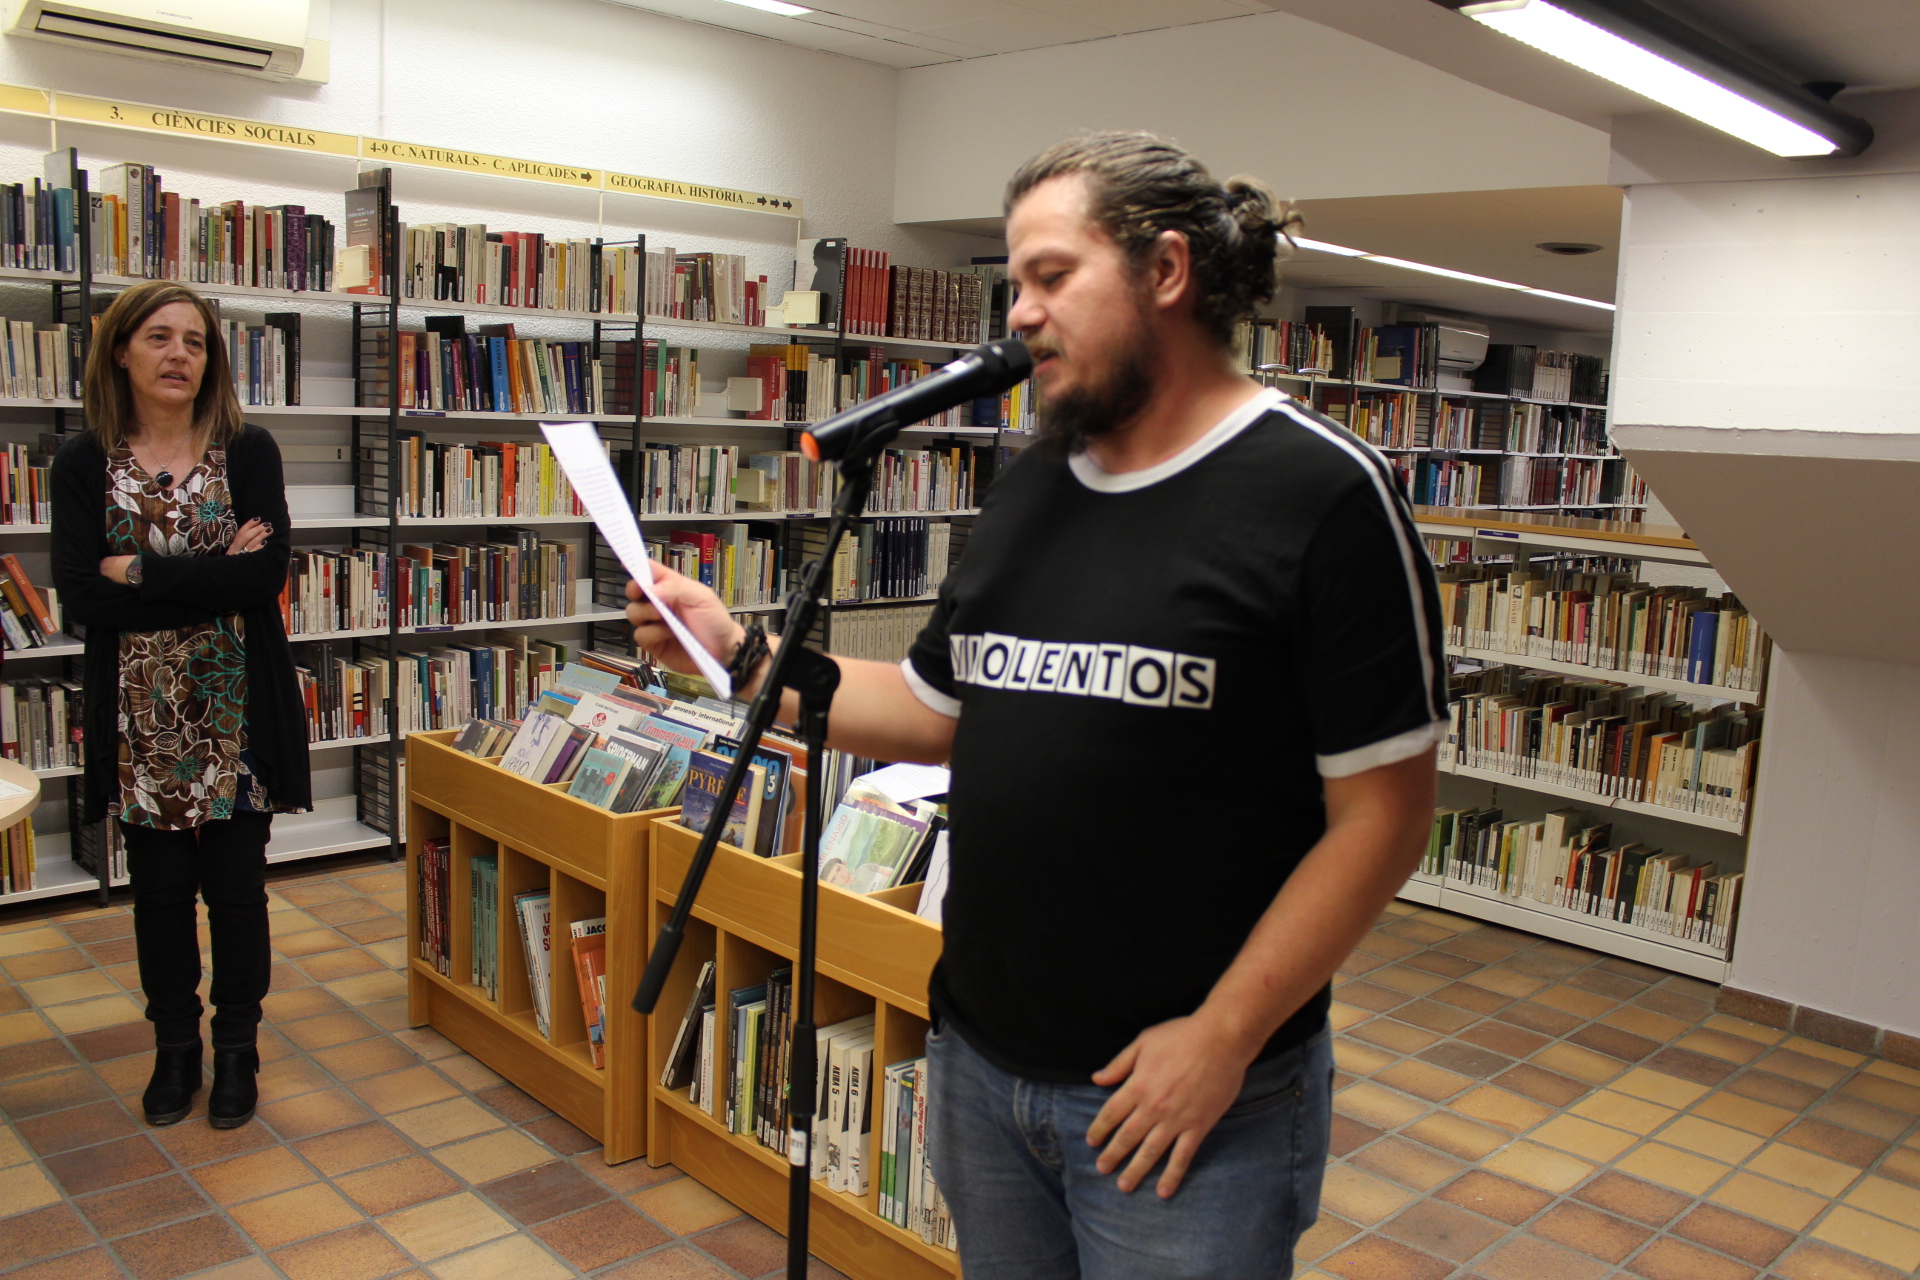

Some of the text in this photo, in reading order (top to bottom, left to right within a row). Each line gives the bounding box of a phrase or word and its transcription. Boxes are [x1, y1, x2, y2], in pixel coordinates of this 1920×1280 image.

[110, 106, 316, 147] 3. CIÈNCIES SOCIALS
[370, 141, 388, 154] 4-9
[391, 144, 405, 157] C.
[408, 146, 480, 167] NATURALS
[493, 159, 506, 171] C.
[508, 161, 577, 181] APLICADES
[611, 174, 686, 196] GEOGRAFIA.
[689, 184, 744, 204] HISTÒRIA
[673, 705, 697, 717] amnesty
[698, 712, 736, 727] international
[640, 716, 698, 750] Commerciaux
[606, 741, 650, 771] SPIDERMAN
[688, 769, 747, 801] PYRÈE
[767, 775, 776, 793] 3
[818, 813, 848, 867] MILENARIO
[832, 1064, 840, 1087] AKIRA
[851, 1065, 859, 1088] AKIRA
[831, 1087, 839, 1095] 5
[850, 1088, 859, 1096] 6
